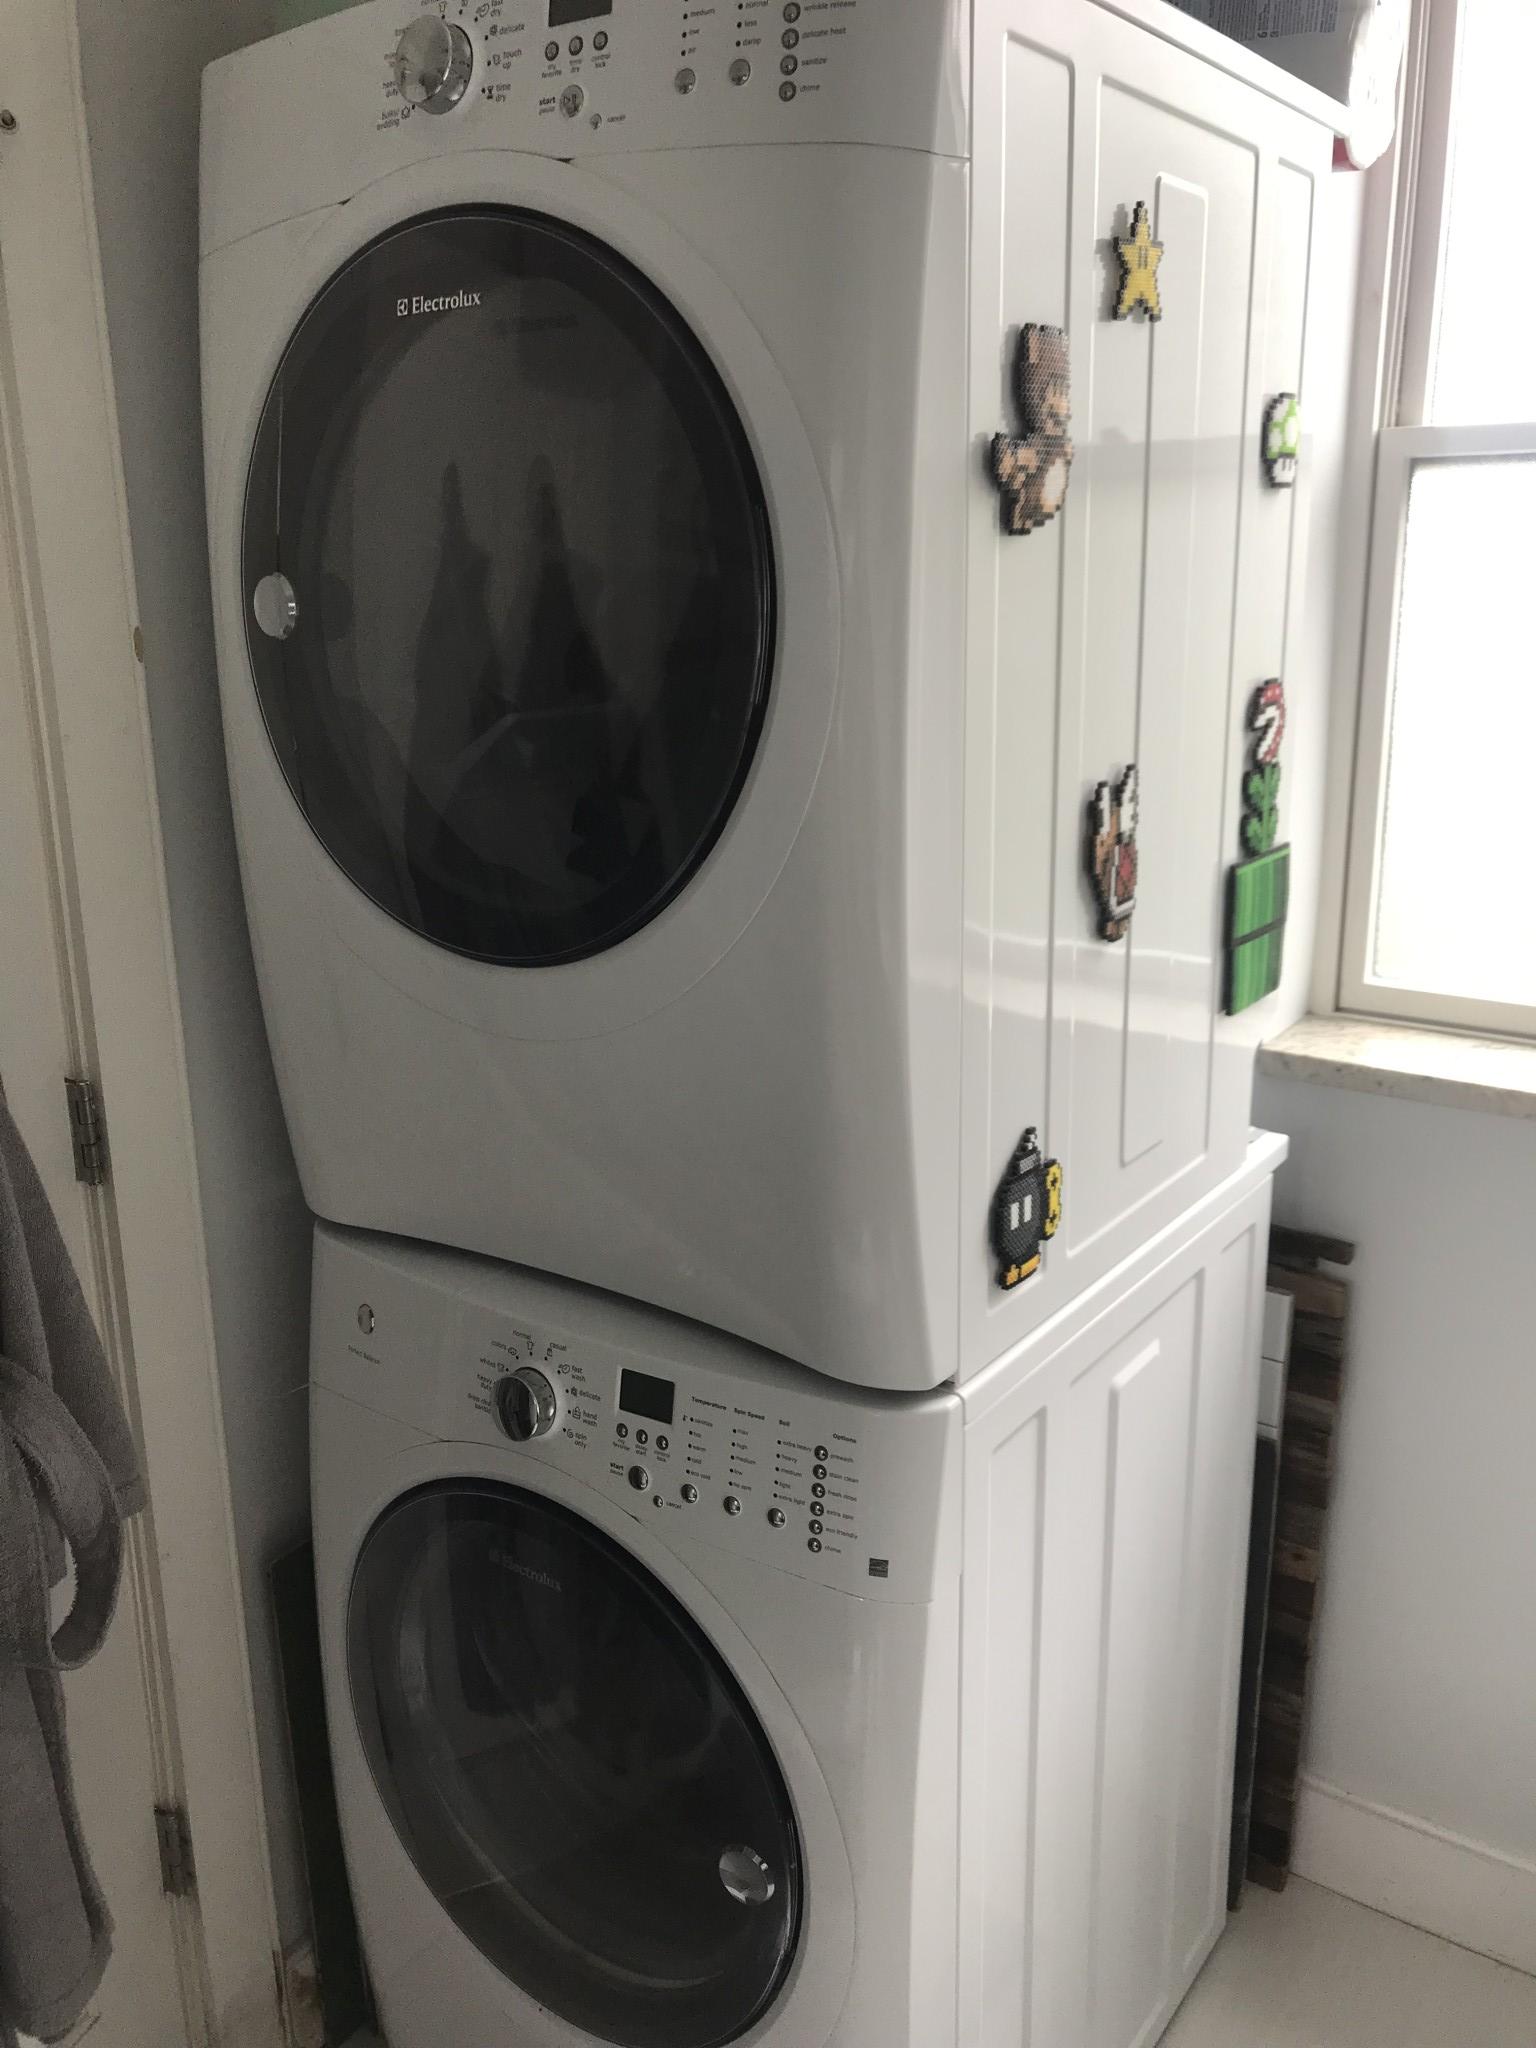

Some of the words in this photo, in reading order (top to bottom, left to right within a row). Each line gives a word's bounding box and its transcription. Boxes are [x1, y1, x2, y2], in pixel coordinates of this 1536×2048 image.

[539, 97, 556, 106] start
[411, 289, 481, 314] Electrolux
[692, 1396, 727, 1410] Temperature
[734, 1407, 746, 1415] Spin
[747, 1411, 766, 1421] Speed
[832, 1433, 857, 1443] Options
[610, 1462, 624, 1471] start
